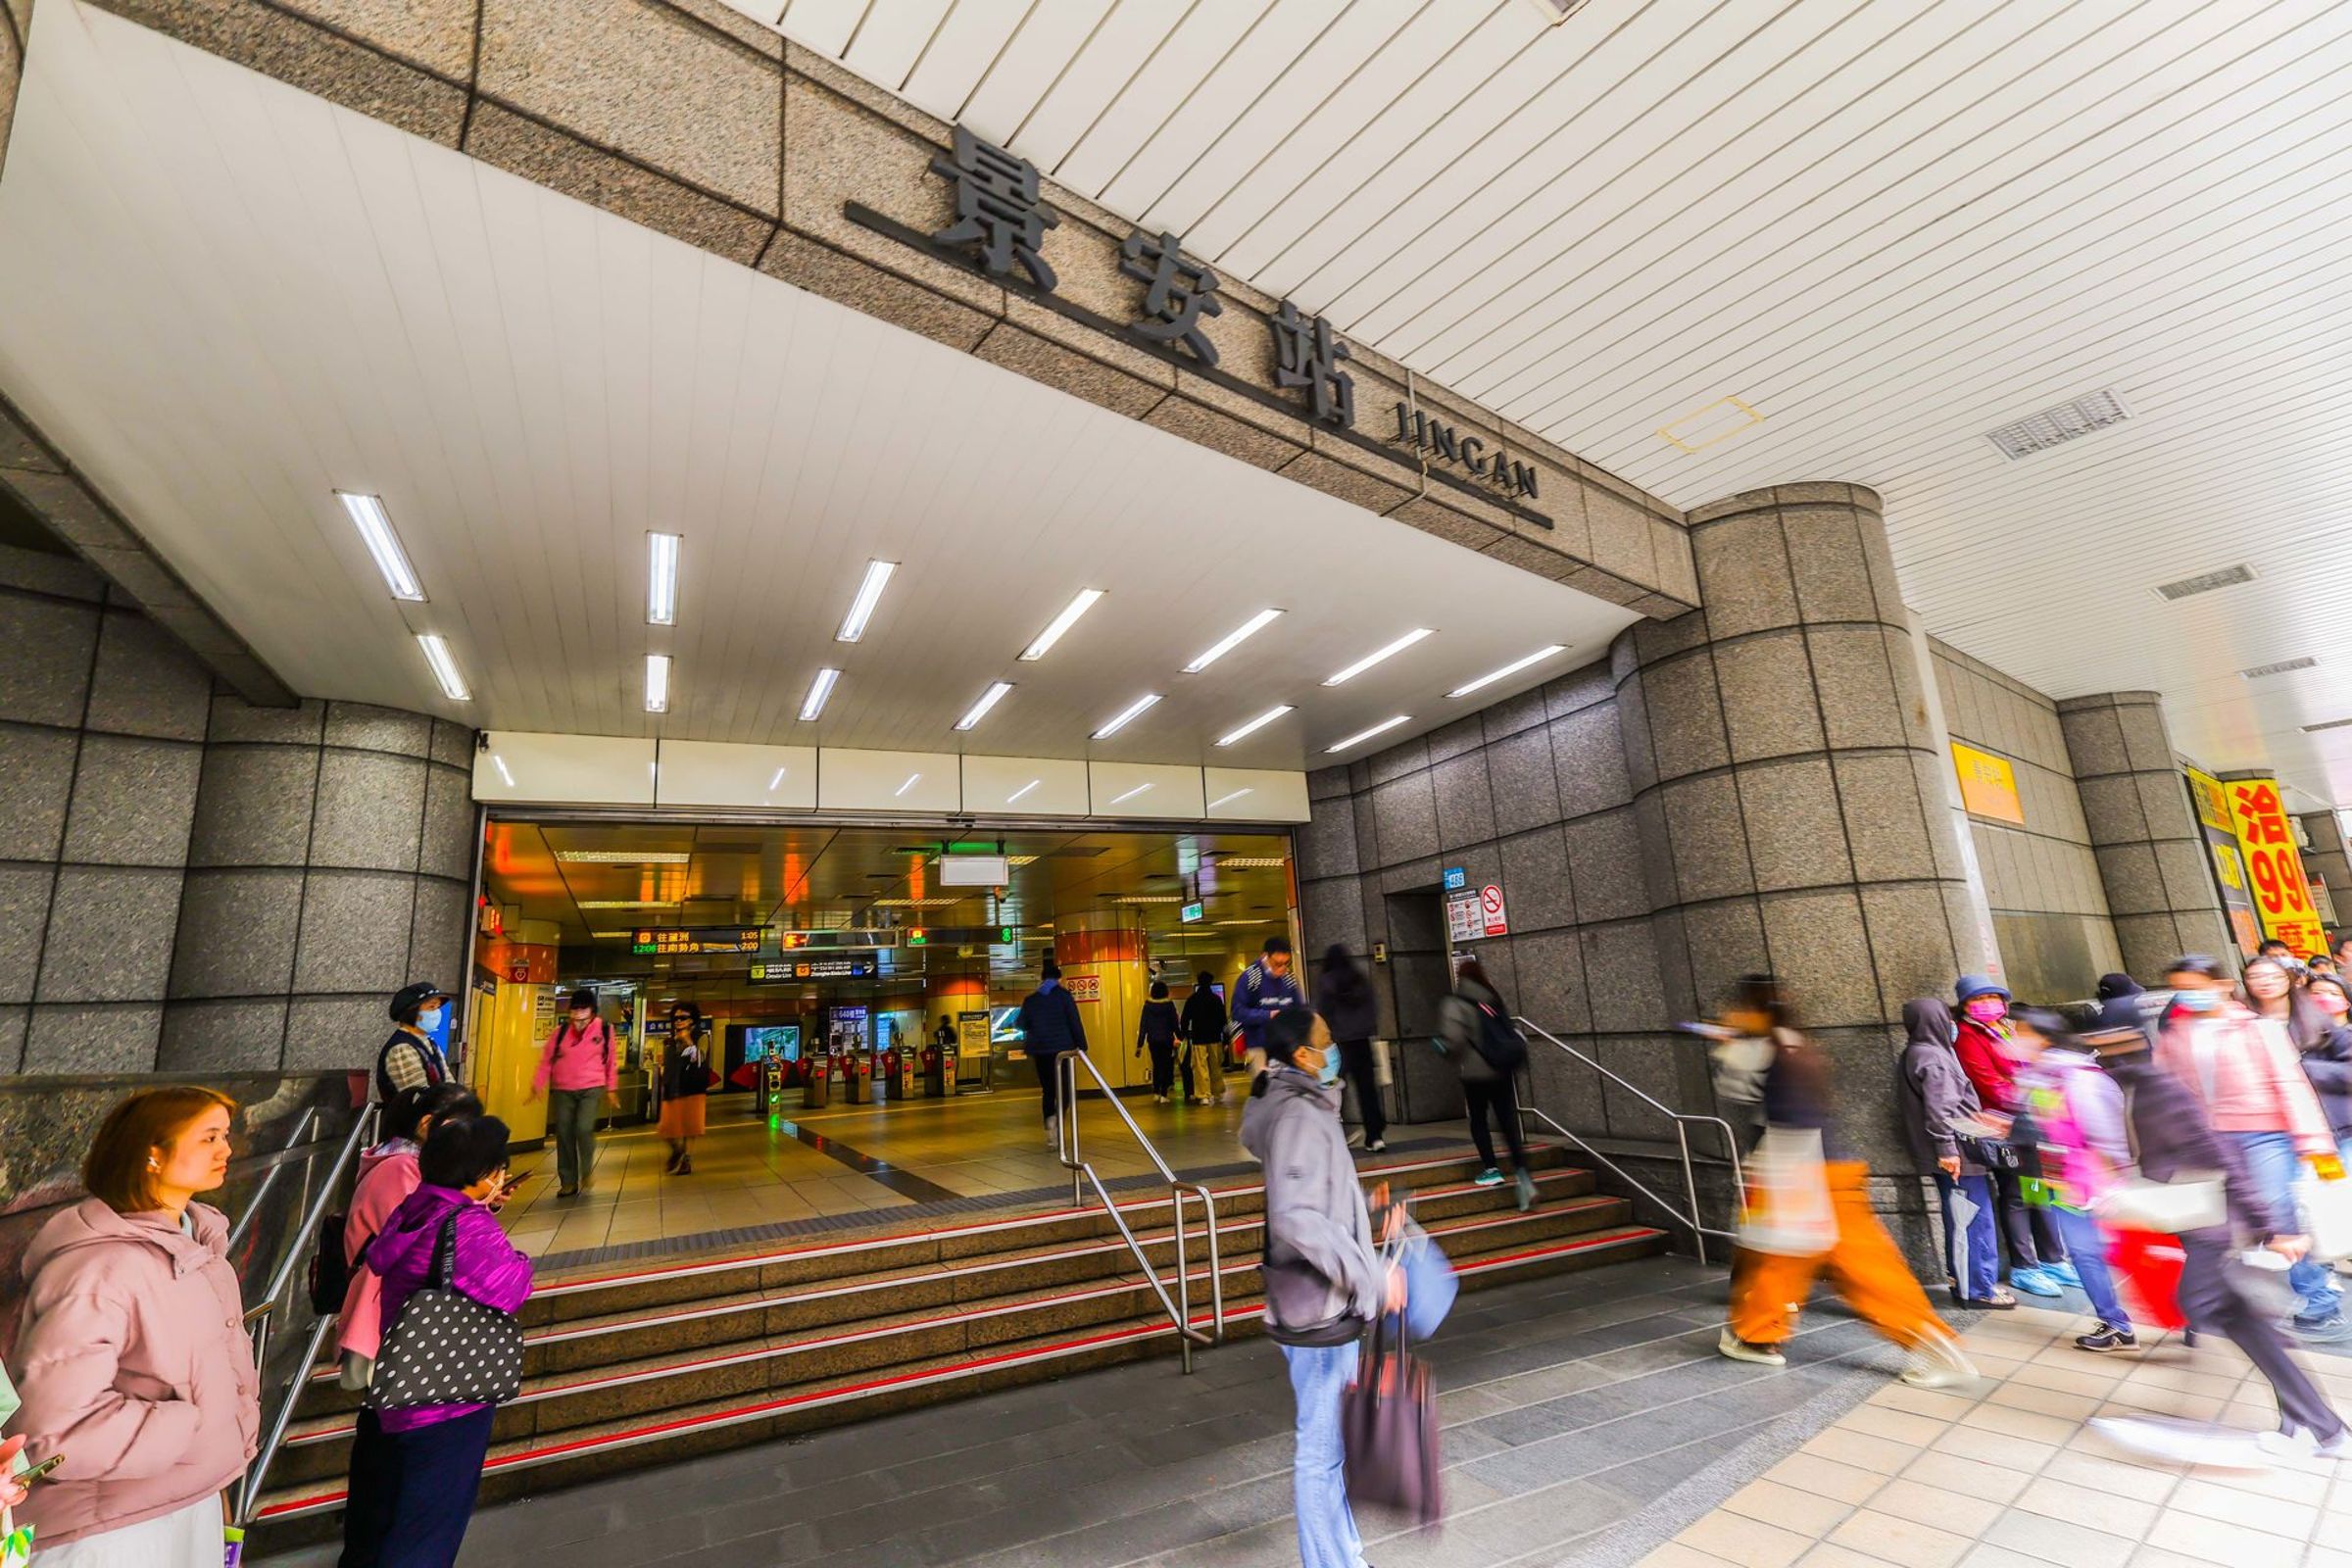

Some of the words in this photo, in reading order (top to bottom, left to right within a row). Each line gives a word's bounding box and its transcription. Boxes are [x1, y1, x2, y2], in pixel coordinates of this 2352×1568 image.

[930, 123, 1354, 429] 景安站
[1396, 401, 1539, 499] JINGAN
[2235, 784, 2289, 845] 洽
